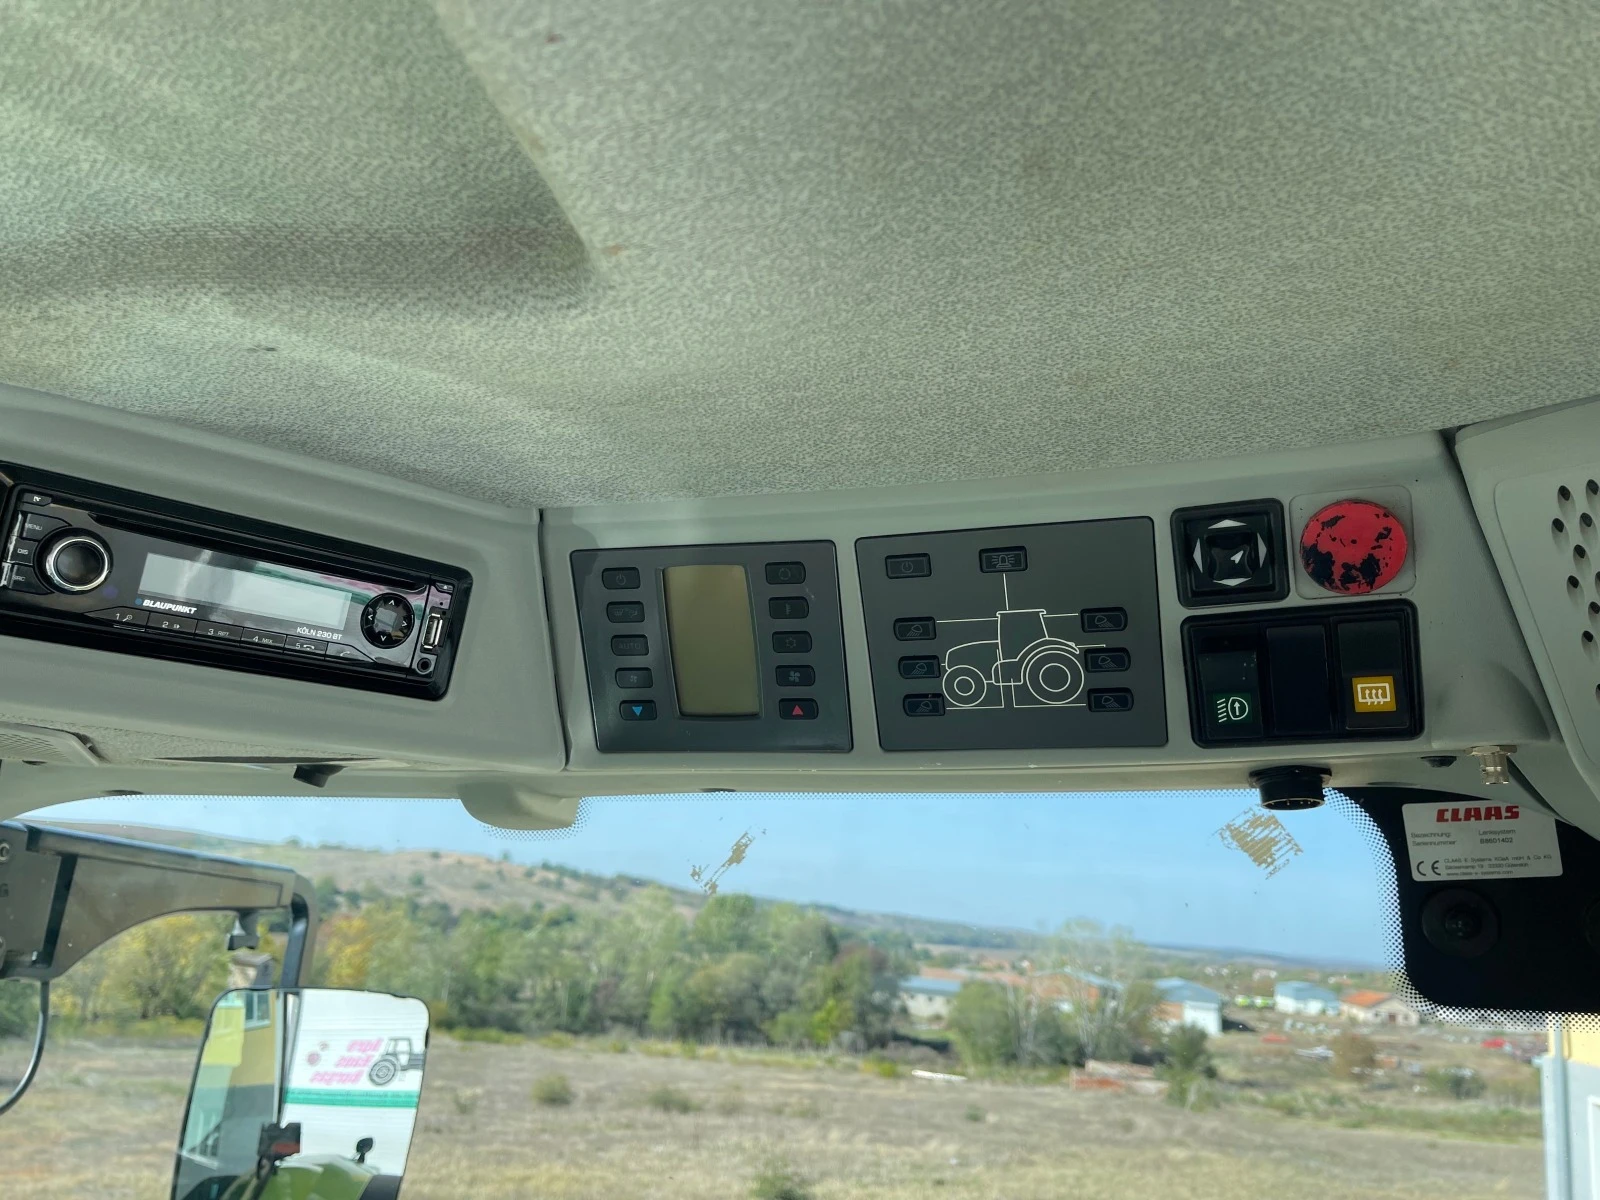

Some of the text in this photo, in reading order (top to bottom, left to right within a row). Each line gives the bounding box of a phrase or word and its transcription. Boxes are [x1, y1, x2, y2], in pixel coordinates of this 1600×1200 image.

[25, 523, 43, 531] MENU
[142, 599, 197, 615] BLAUPUNKT
[162, 621, 168, 629] 2
[207, 628, 214, 636] 3
[296, 626, 343, 641] KÖLN 230 BT
[252, 635, 259, 643] 4
[619, 642, 641, 650] AUTO
[1436, 805, 1520, 822] CLAAS
[1478, 828, 1516, 836] Lenksystem
